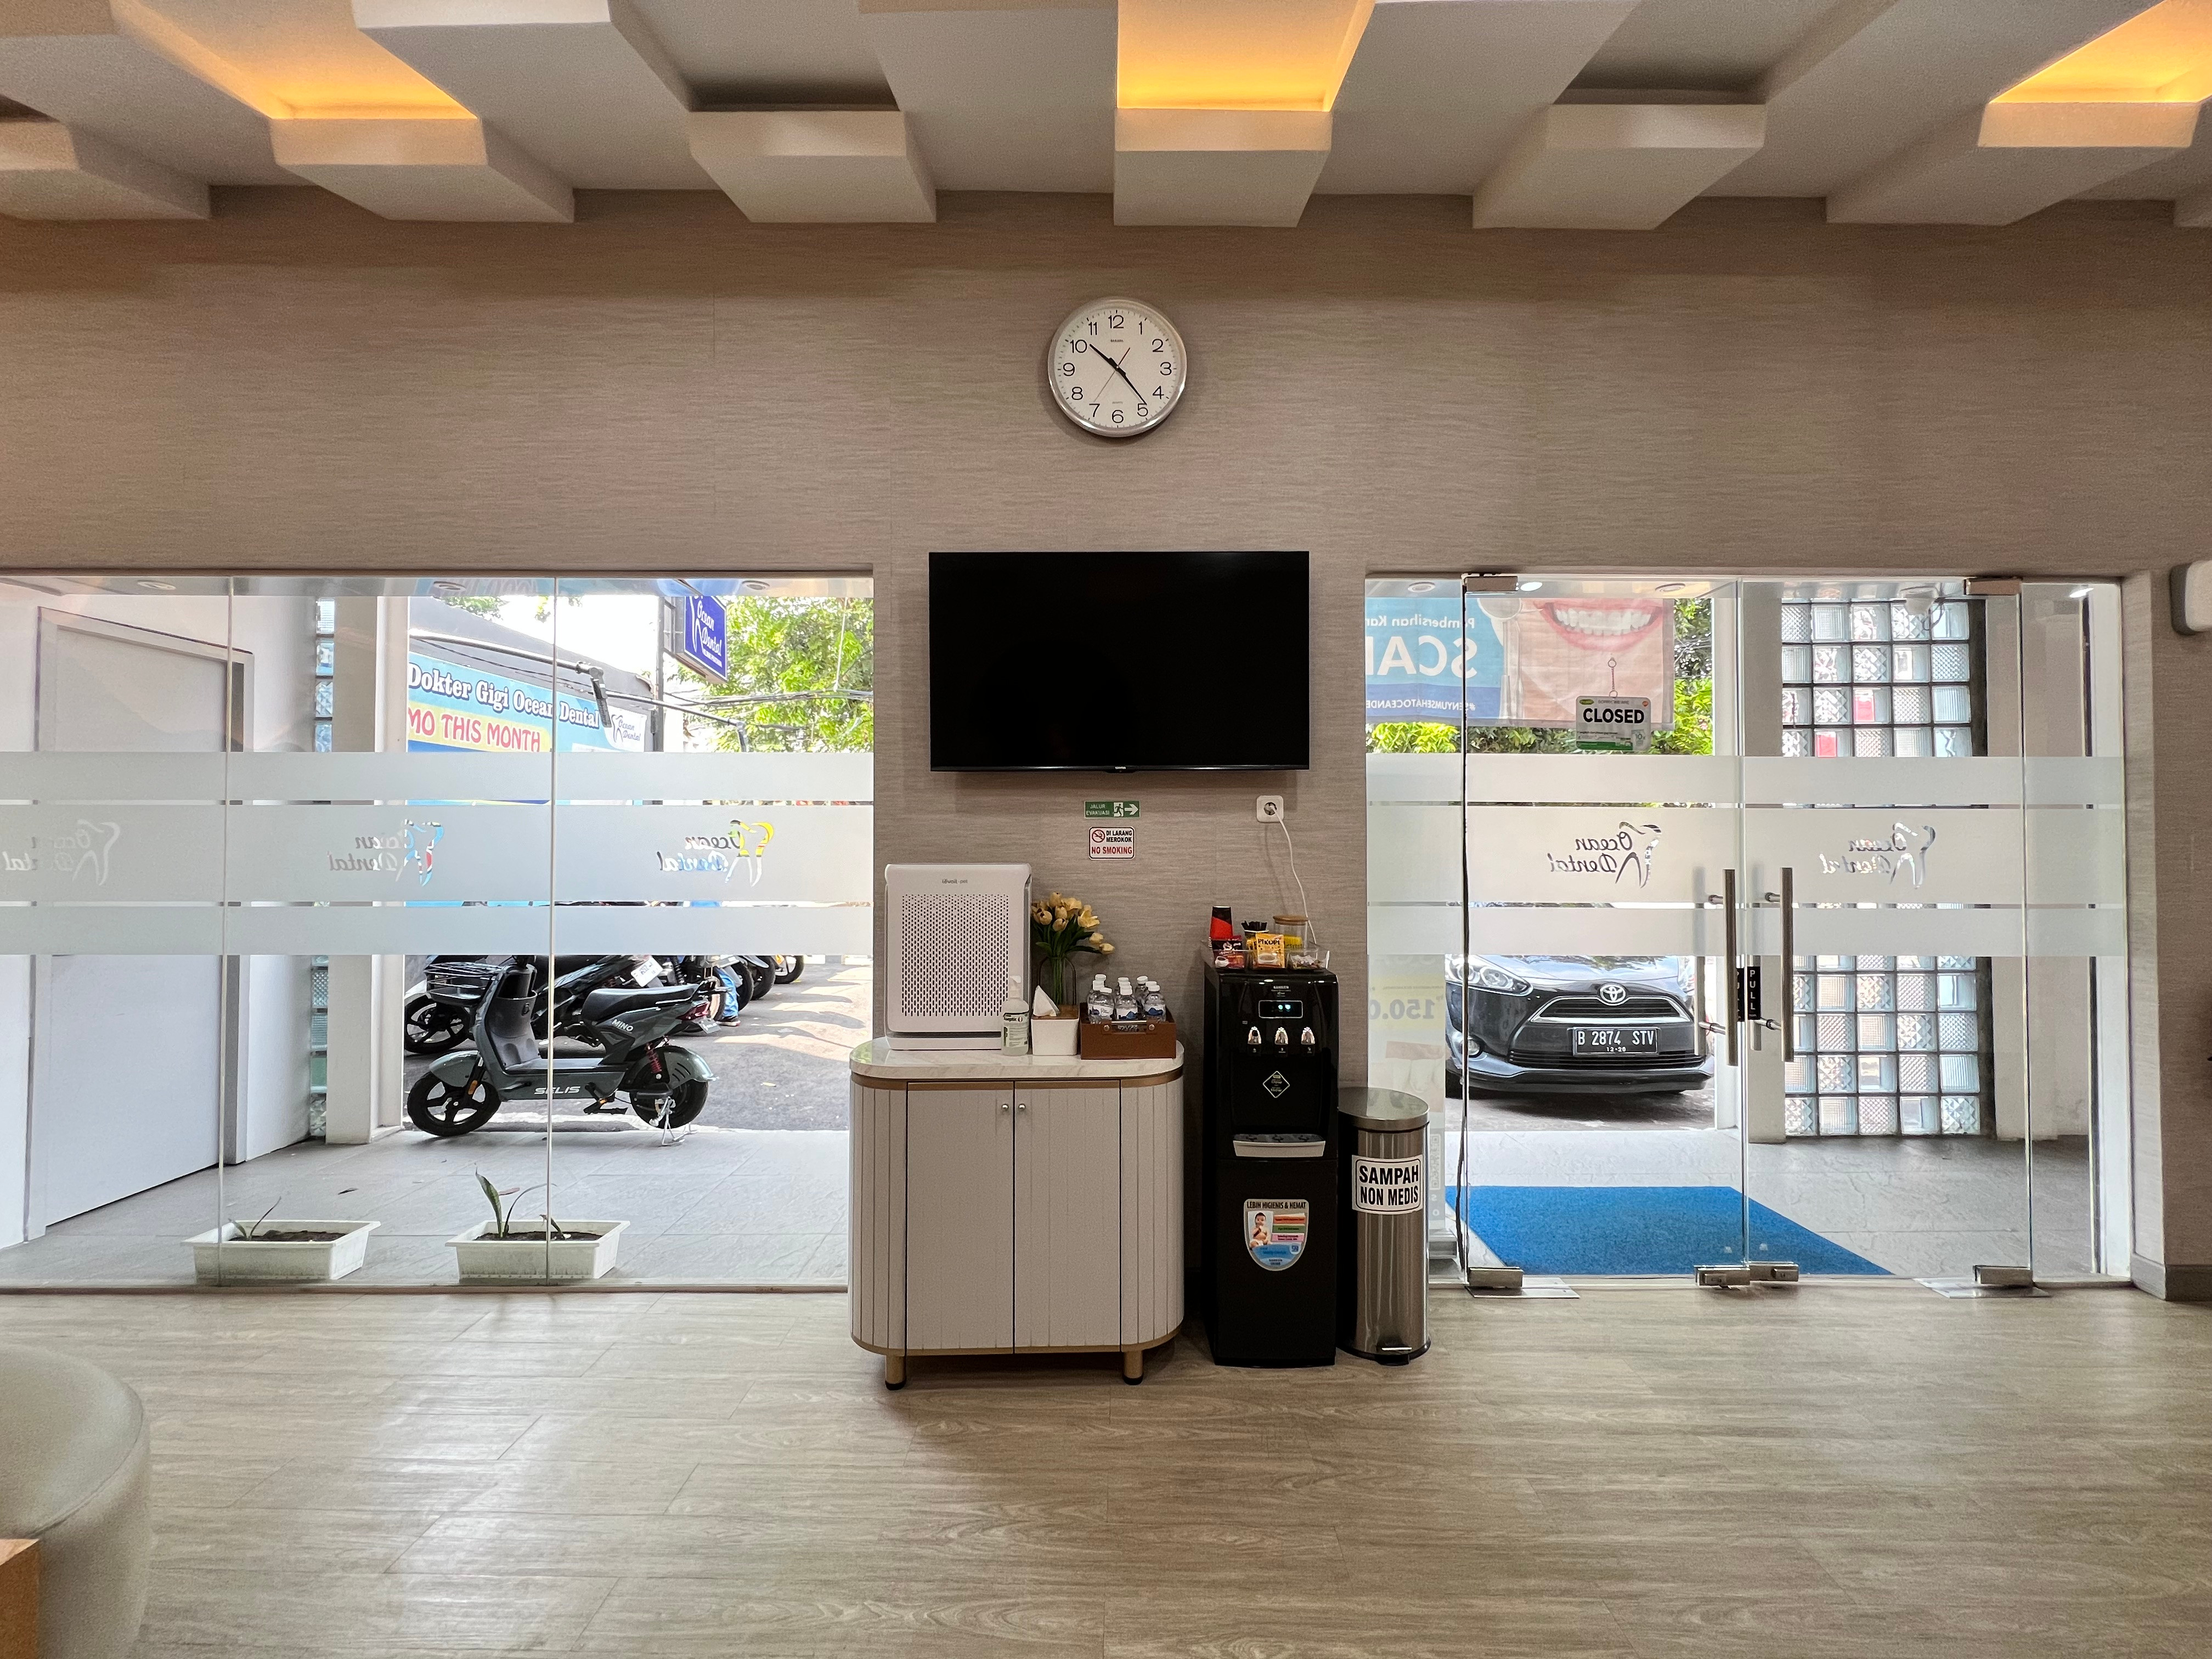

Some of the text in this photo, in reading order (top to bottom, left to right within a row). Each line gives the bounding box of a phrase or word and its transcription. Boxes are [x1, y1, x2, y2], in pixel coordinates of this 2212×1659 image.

[1088, 321, 1097, 335] 11
[1108, 315, 1124, 329] 12
[1139, 321, 1142, 335] 1
[1070, 339, 1087, 353] 10
[1152, 338, 1164, 352] 2
[1063, 363, 1075, 376] 9
[1160, 362, 1172, 375] 3
[1071, 387, 1083, 400] 8
[1153, 386, 1164, 399] 4
[1089, 403, 1100, 417] 7
[1112, 410, 1124, 423] 6
[1137, 403, 1148, 416] 5
[409, 663, 472, 699] Dokter
[476, 682, 509, 713] Gigi
[560, 702, 600, 730] Dental
[1583, 708, 1644, 723] CLOSED
[619, 719, 635, 730] Ocean
[441, 714, 481, 743] THIS
[487, 723, 540, 753] MONTH
[612, 1019, 634, 1032] MINO
[1578, 1031, 1654, 1045] B 2874 STV
[1359, 1165, 1419, 1186] SAMPAH
[1360, 1185, 1419, 1205] NON MEDIS
